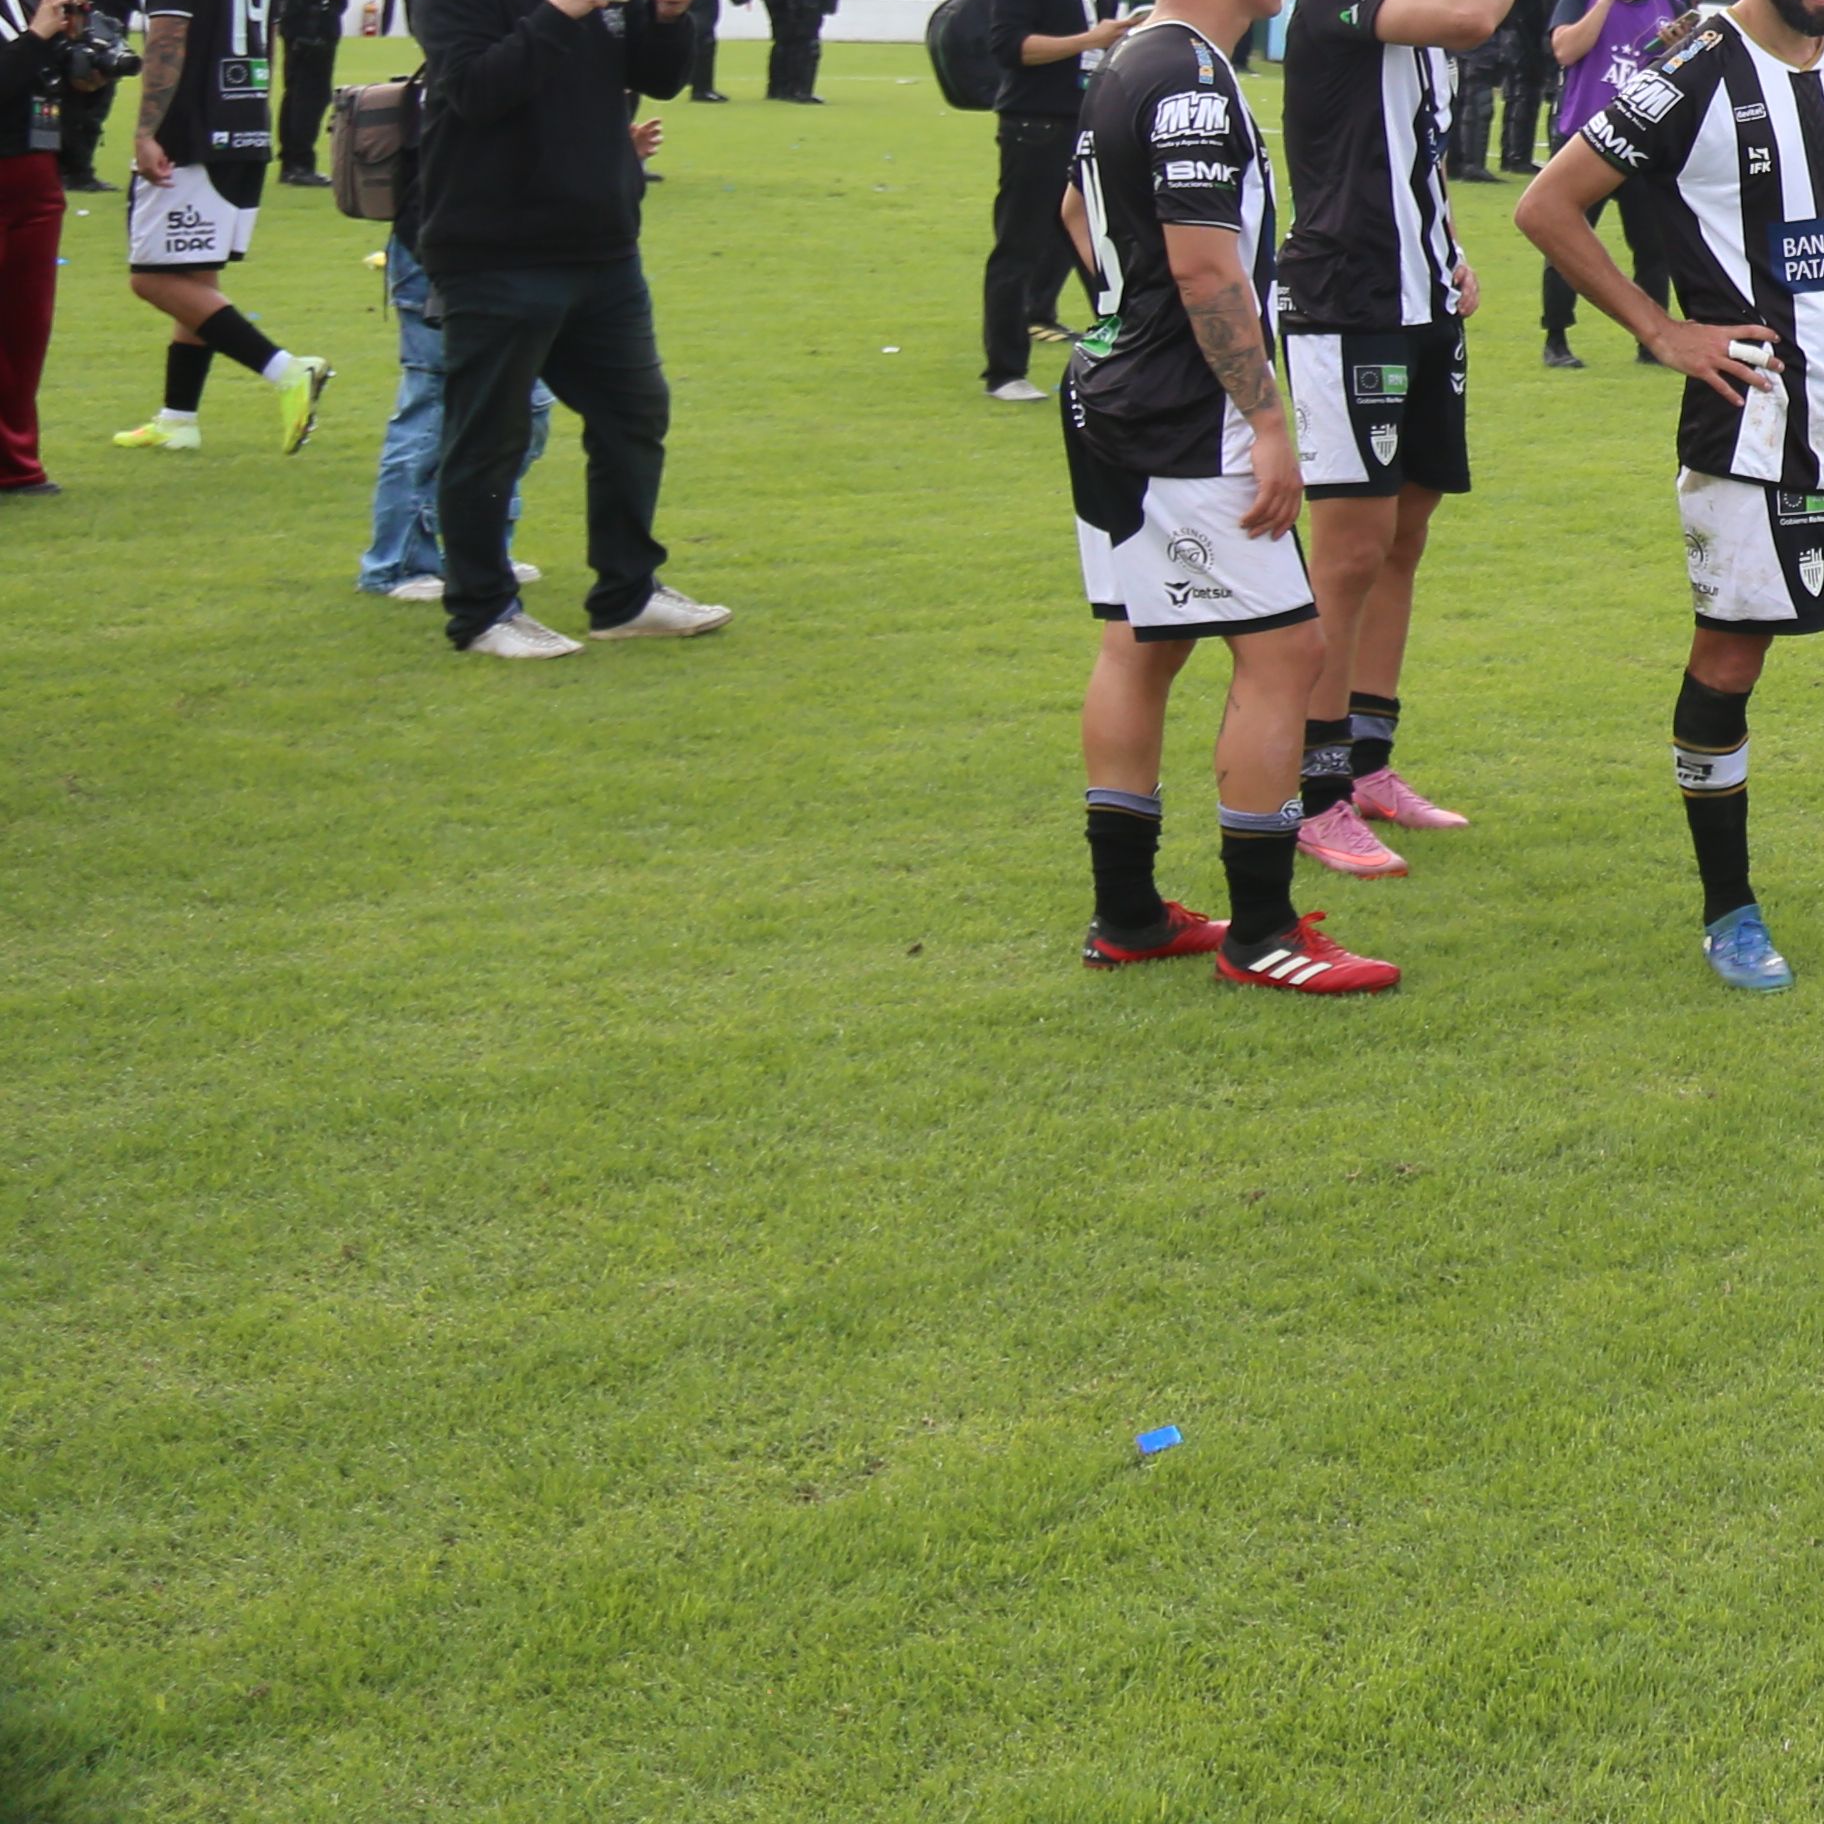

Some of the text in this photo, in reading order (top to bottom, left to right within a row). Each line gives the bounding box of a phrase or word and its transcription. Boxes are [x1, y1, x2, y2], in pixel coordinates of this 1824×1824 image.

[1586, 111, 1649, 168] BMK
[1166, 161, 1240, 185] BMK
[1750, 160, 1772, 175] IFK
[165, 236, 216, 254] IDAC
